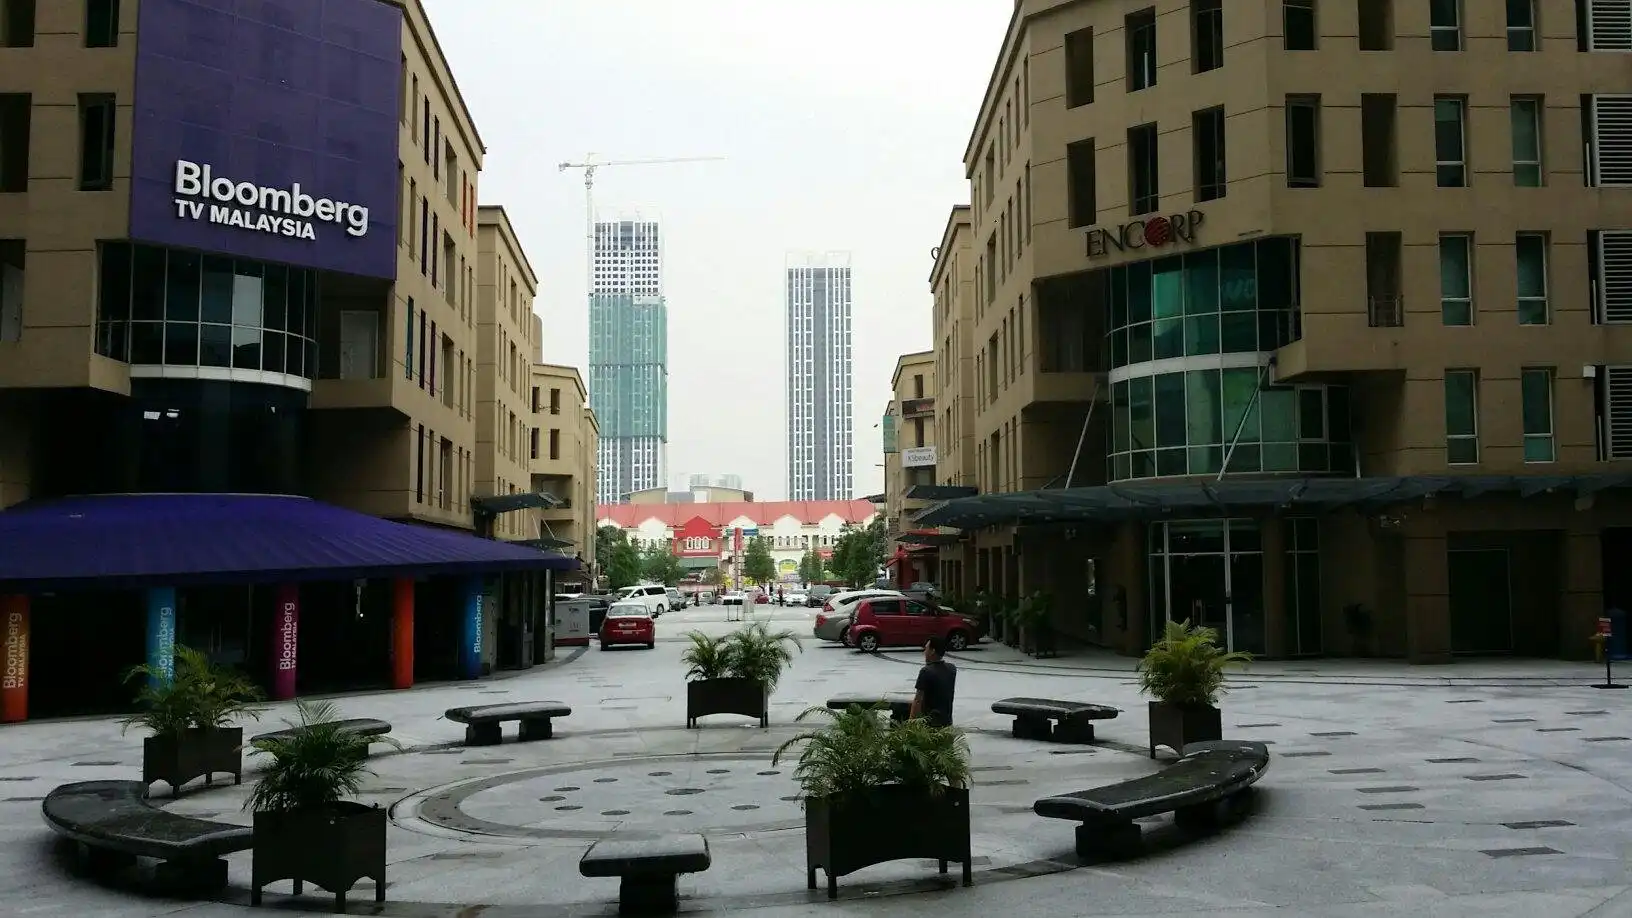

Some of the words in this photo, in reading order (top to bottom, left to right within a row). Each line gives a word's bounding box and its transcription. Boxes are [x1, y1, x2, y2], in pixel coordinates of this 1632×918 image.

[175, 159, 369, 237] Bloomberg
[175, 199, 205, 220] TV
[209, 205, 316, 240] MALAYSIA
[1085, 210, 1205, 257] ENCORP
[3, 612, 23, 689] Bloomberg
[279, 602, 295, 670] Bloomberg
[473, 595, 482, 653] Bloomberg
